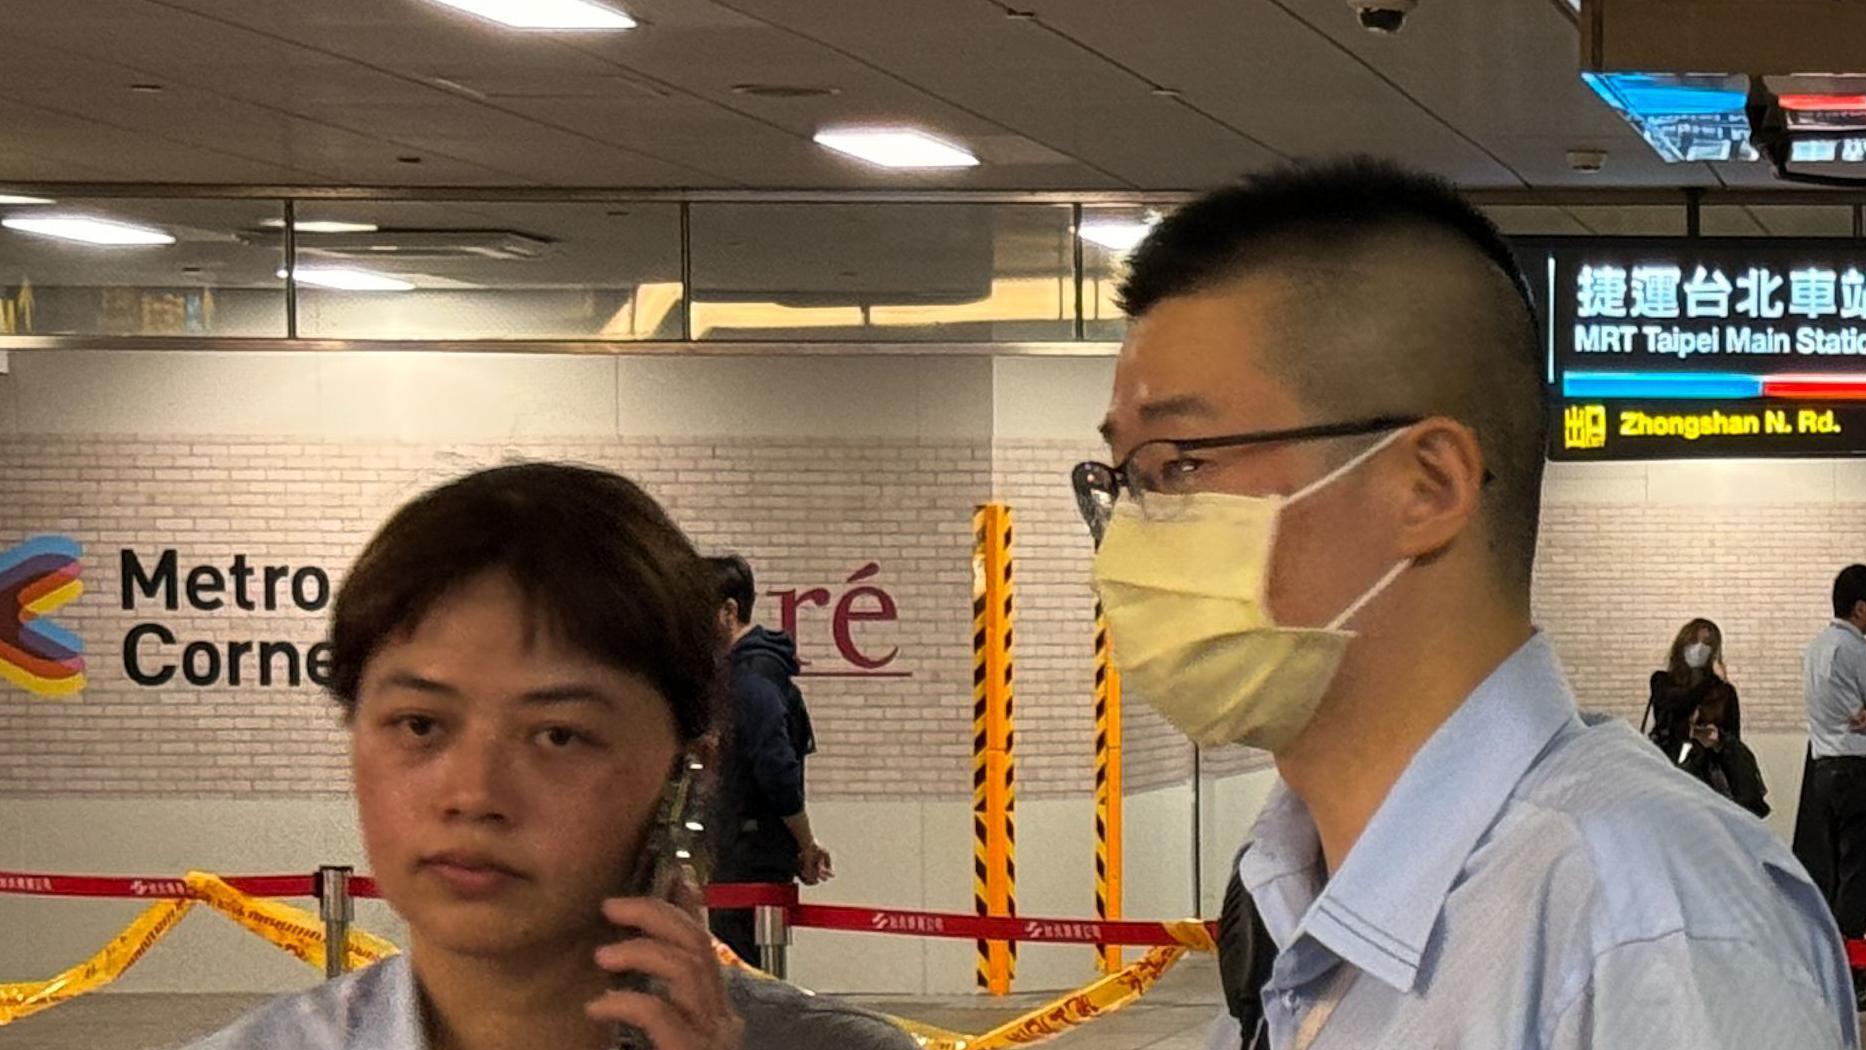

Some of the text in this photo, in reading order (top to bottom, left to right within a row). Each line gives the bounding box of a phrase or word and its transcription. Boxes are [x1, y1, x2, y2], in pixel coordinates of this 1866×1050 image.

[1574, 325, 1639, 354] MRT
[1642, 325, 1719, 358] Taipei
[1725, 326, 1791, 354] Main
[1619, 409, 1842, 440] Zhongshan N. Rd.
[120, 548, 330, 611] Metro
[122, 622, 333, 686] Corne
